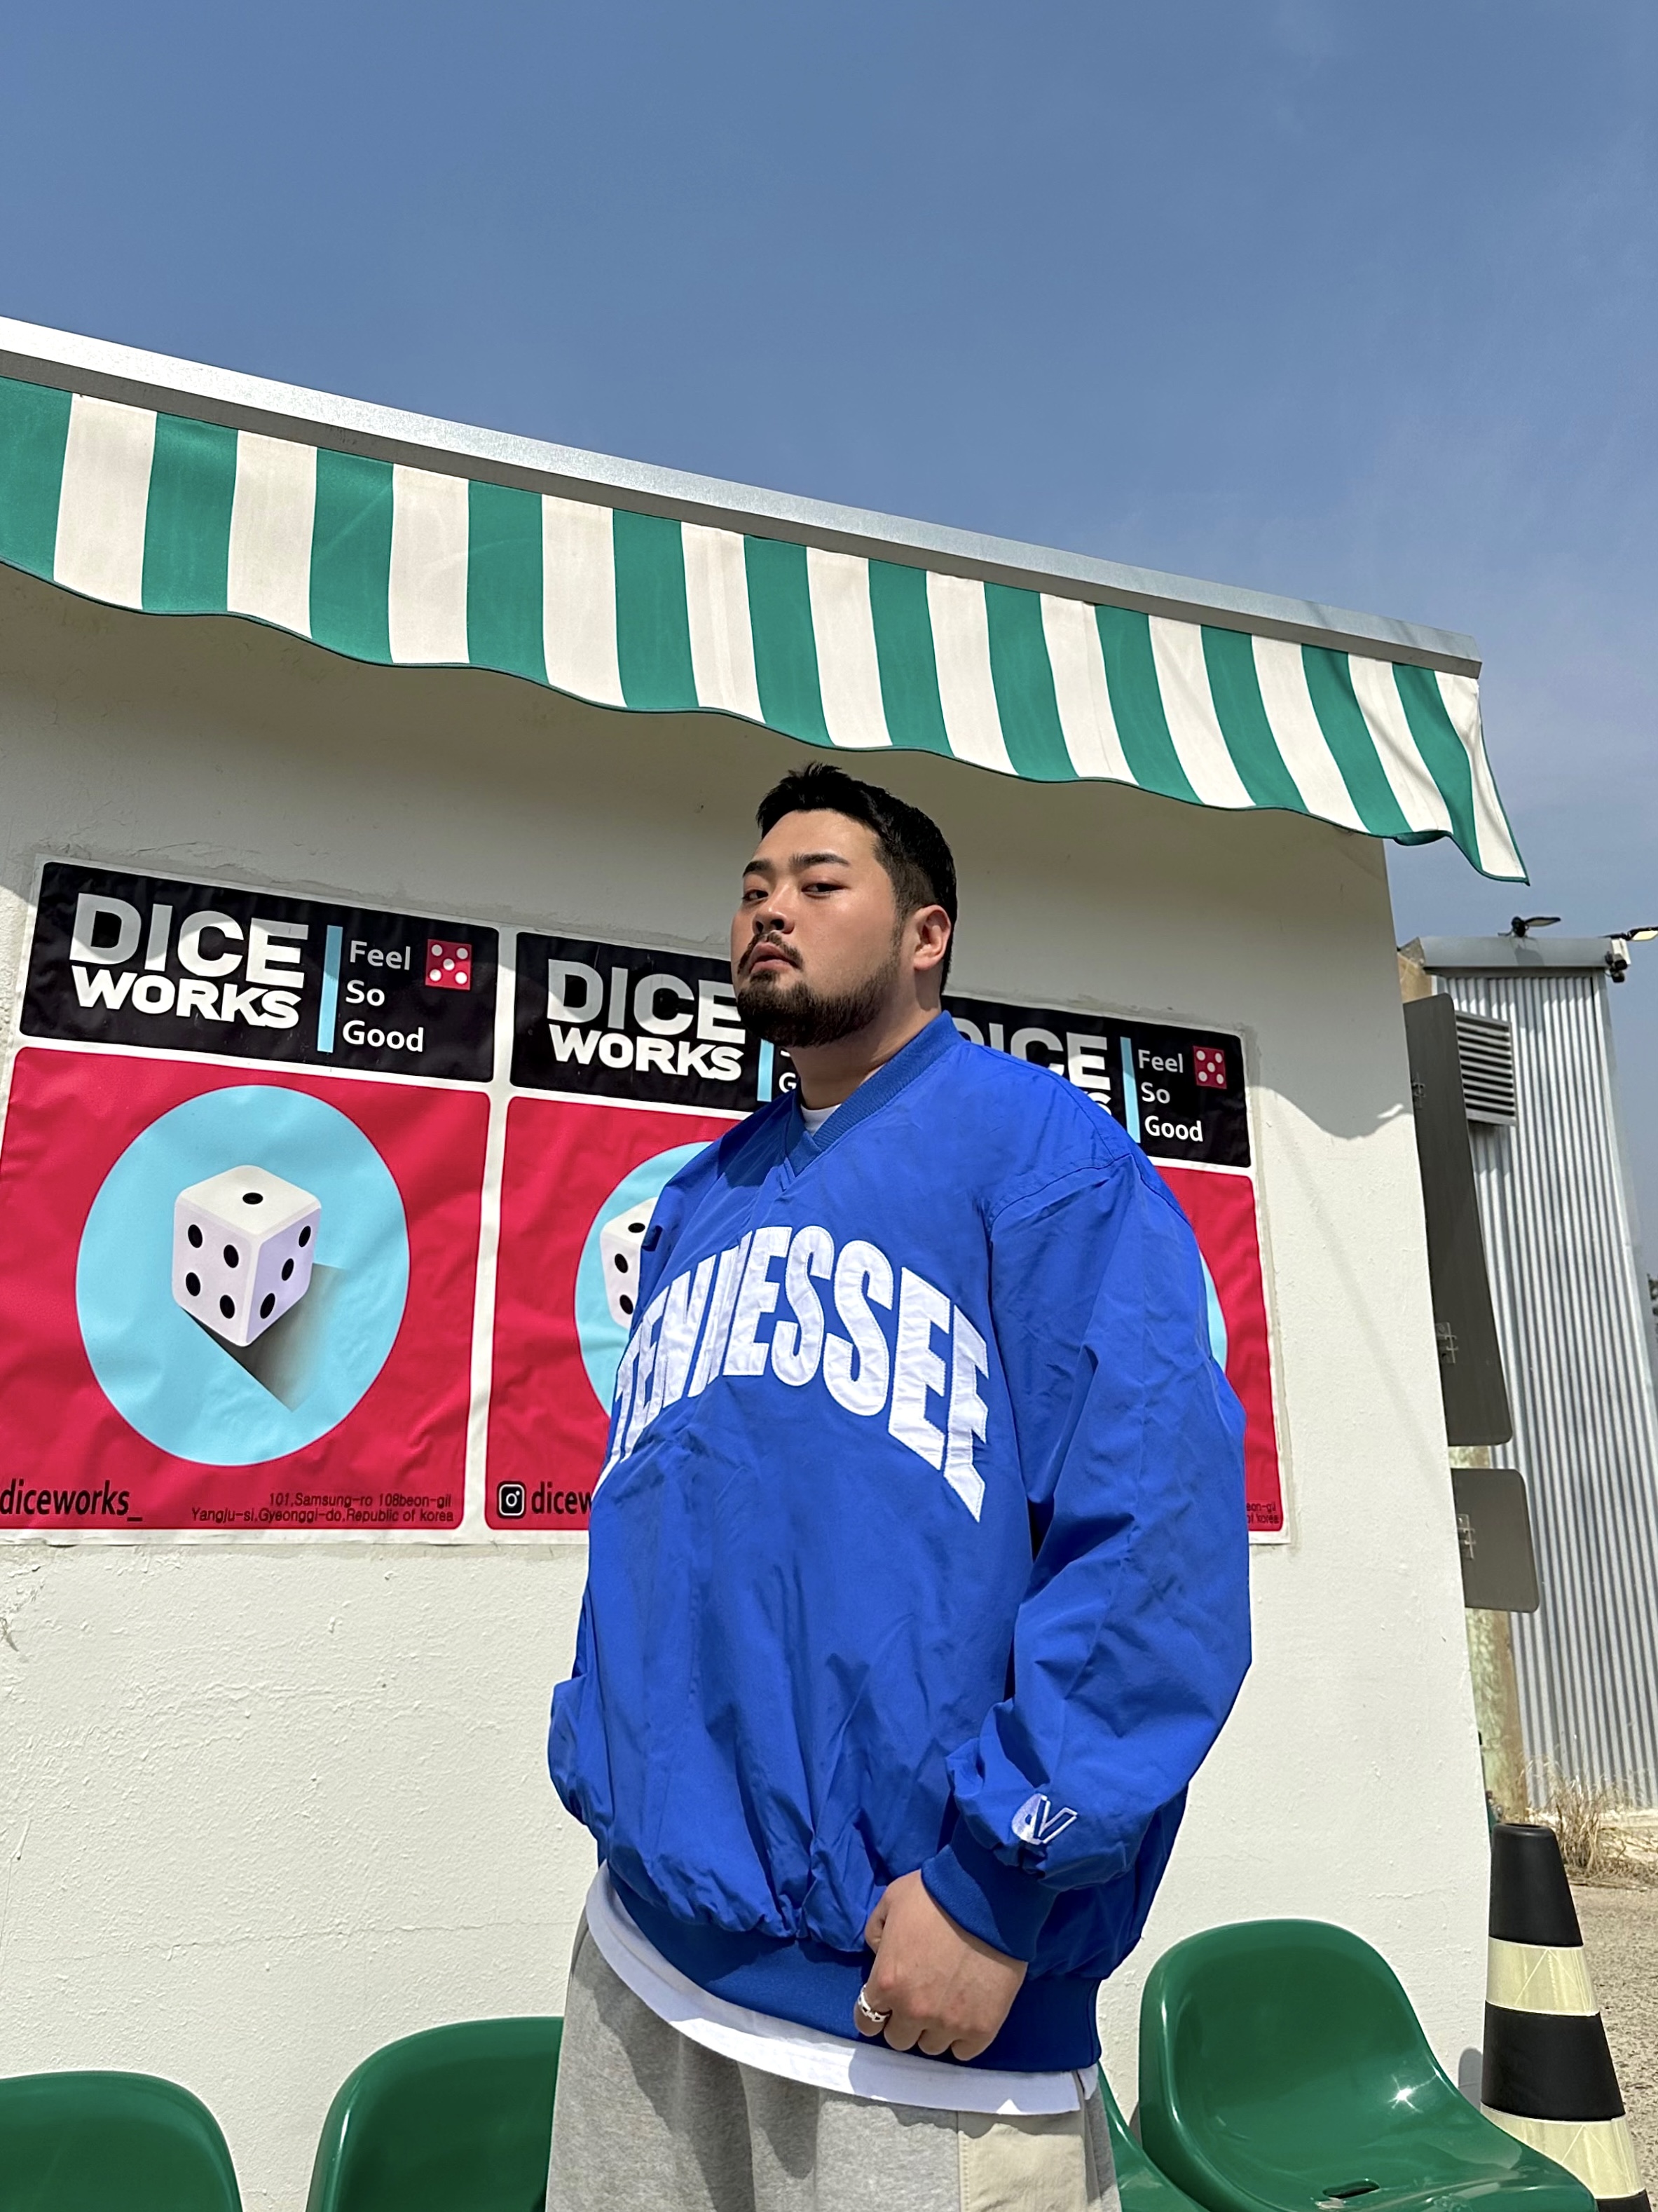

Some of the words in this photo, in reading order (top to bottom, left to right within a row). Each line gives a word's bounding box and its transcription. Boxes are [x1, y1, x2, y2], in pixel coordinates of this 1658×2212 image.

[69, 892, 309, 988] DICE
[349, 941, 411, 971] Feel
[71, 965, 301, 1028] WORKS
[345, 981, 385, 1006] So
[547, 959, 746, 1044] DICE
[342, 1020, 424, 1052] Good
[549, 1024, 744, 1081] WORKS
[1138, 1050, 1184, 1073] Feel
[1141, 1082, 1170, 1104] So
[1144, 1115, 1203, 1142] Good
[402, 1508, 416, 1522] of
[420, 1508, 453, 1522] korea
